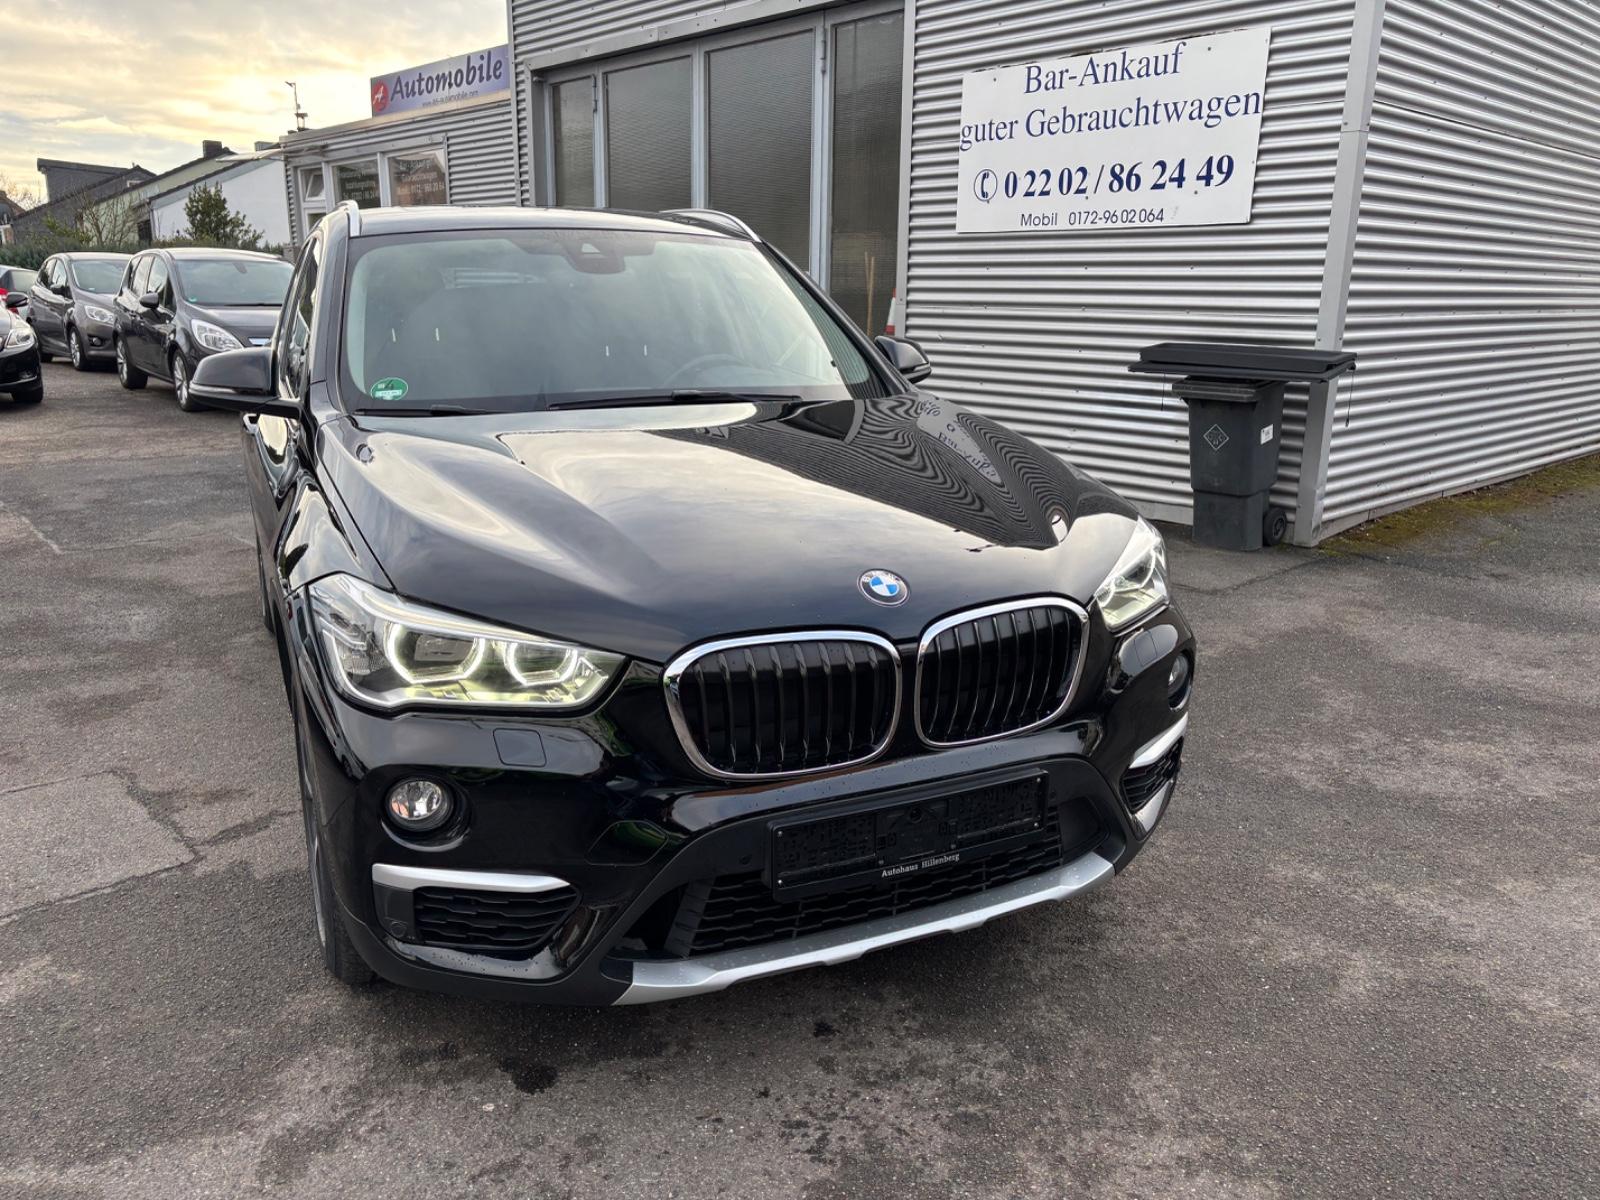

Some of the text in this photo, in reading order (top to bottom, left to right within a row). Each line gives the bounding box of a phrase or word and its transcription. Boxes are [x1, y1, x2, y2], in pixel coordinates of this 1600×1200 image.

[390, 50, 503, 102] Automobile
[1024, 41, 1187, 94] Bar-Ankauf
[959, 91, 1261, 151] guter Gebrauchtwagen
[1020, 213, 1058, 227] Mobil
[881, 864, 918, 877] Autohaus
